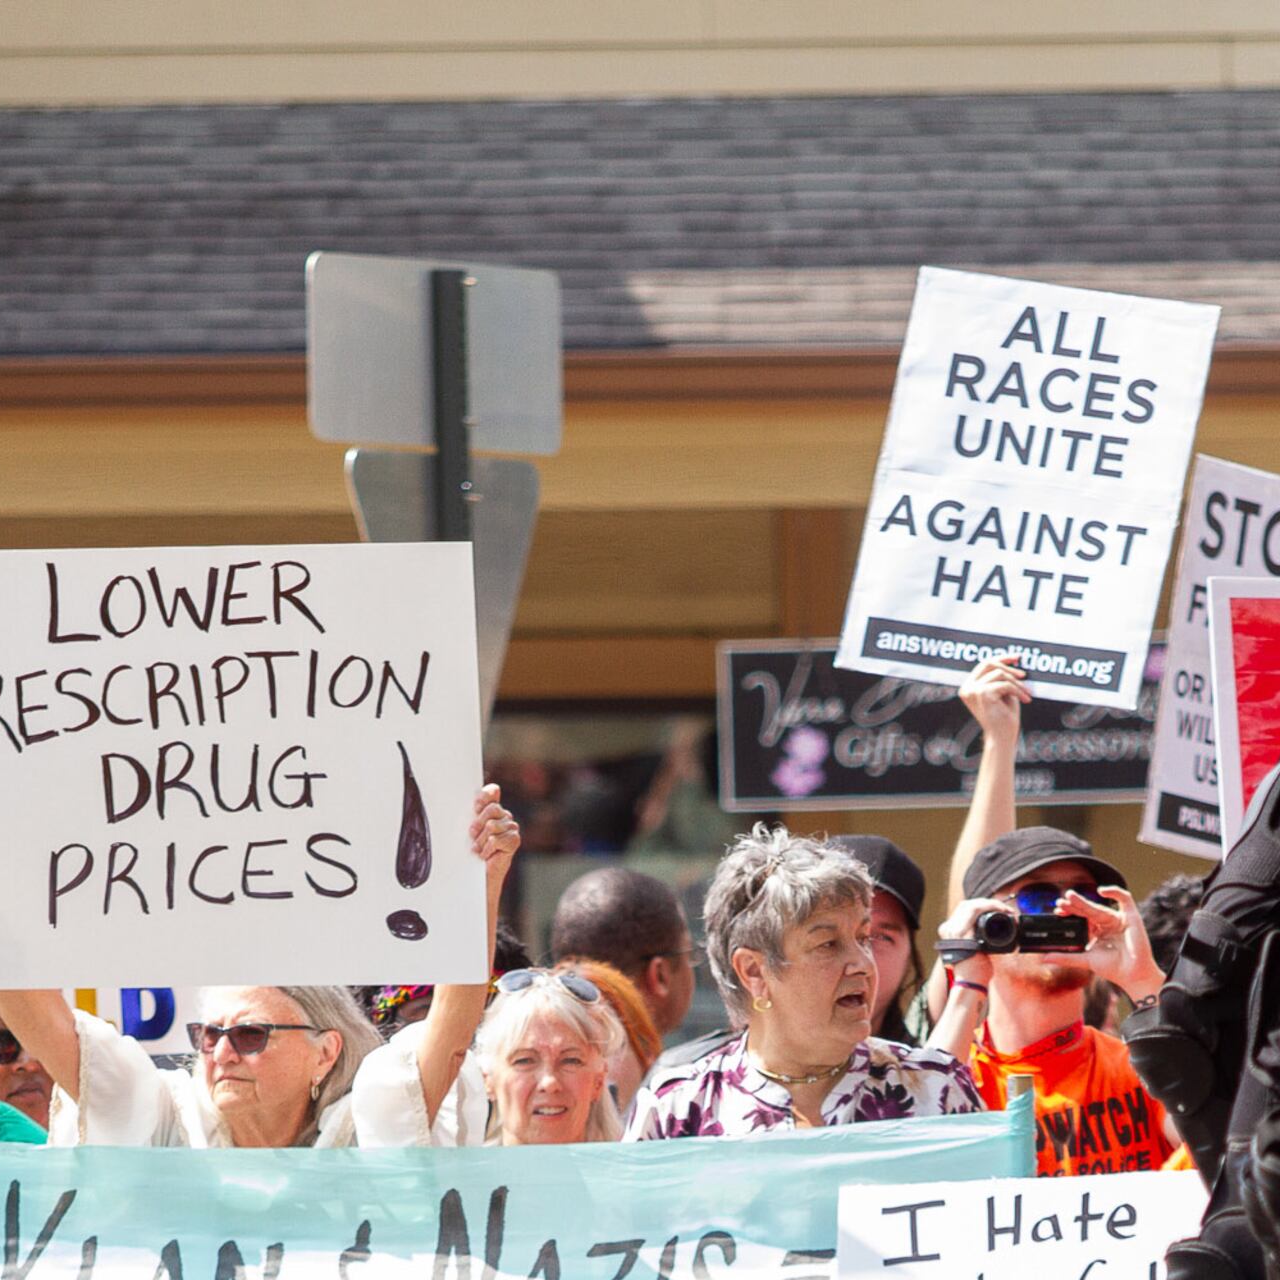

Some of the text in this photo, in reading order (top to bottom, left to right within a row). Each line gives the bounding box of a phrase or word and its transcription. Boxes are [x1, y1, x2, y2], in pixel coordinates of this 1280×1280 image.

[1001, 306, 1121, 364] ALL
[945, 353, 1158, 423] RACES
[954, 415, 1129, 478] UNITE
[880, 495, 1148, 566] AGAINST
[48, 560, 325, 643] LOWER
[932, 557, 1089, 617] HATE
[1175, 670, 1205, 703] OR
[1177, 709, 1215, 746] WIL
[101, 740, 327, 824] DRUG
[49, 833, 359, 928] PRICES
[881, 1192, 1138, 1267] I Hate
